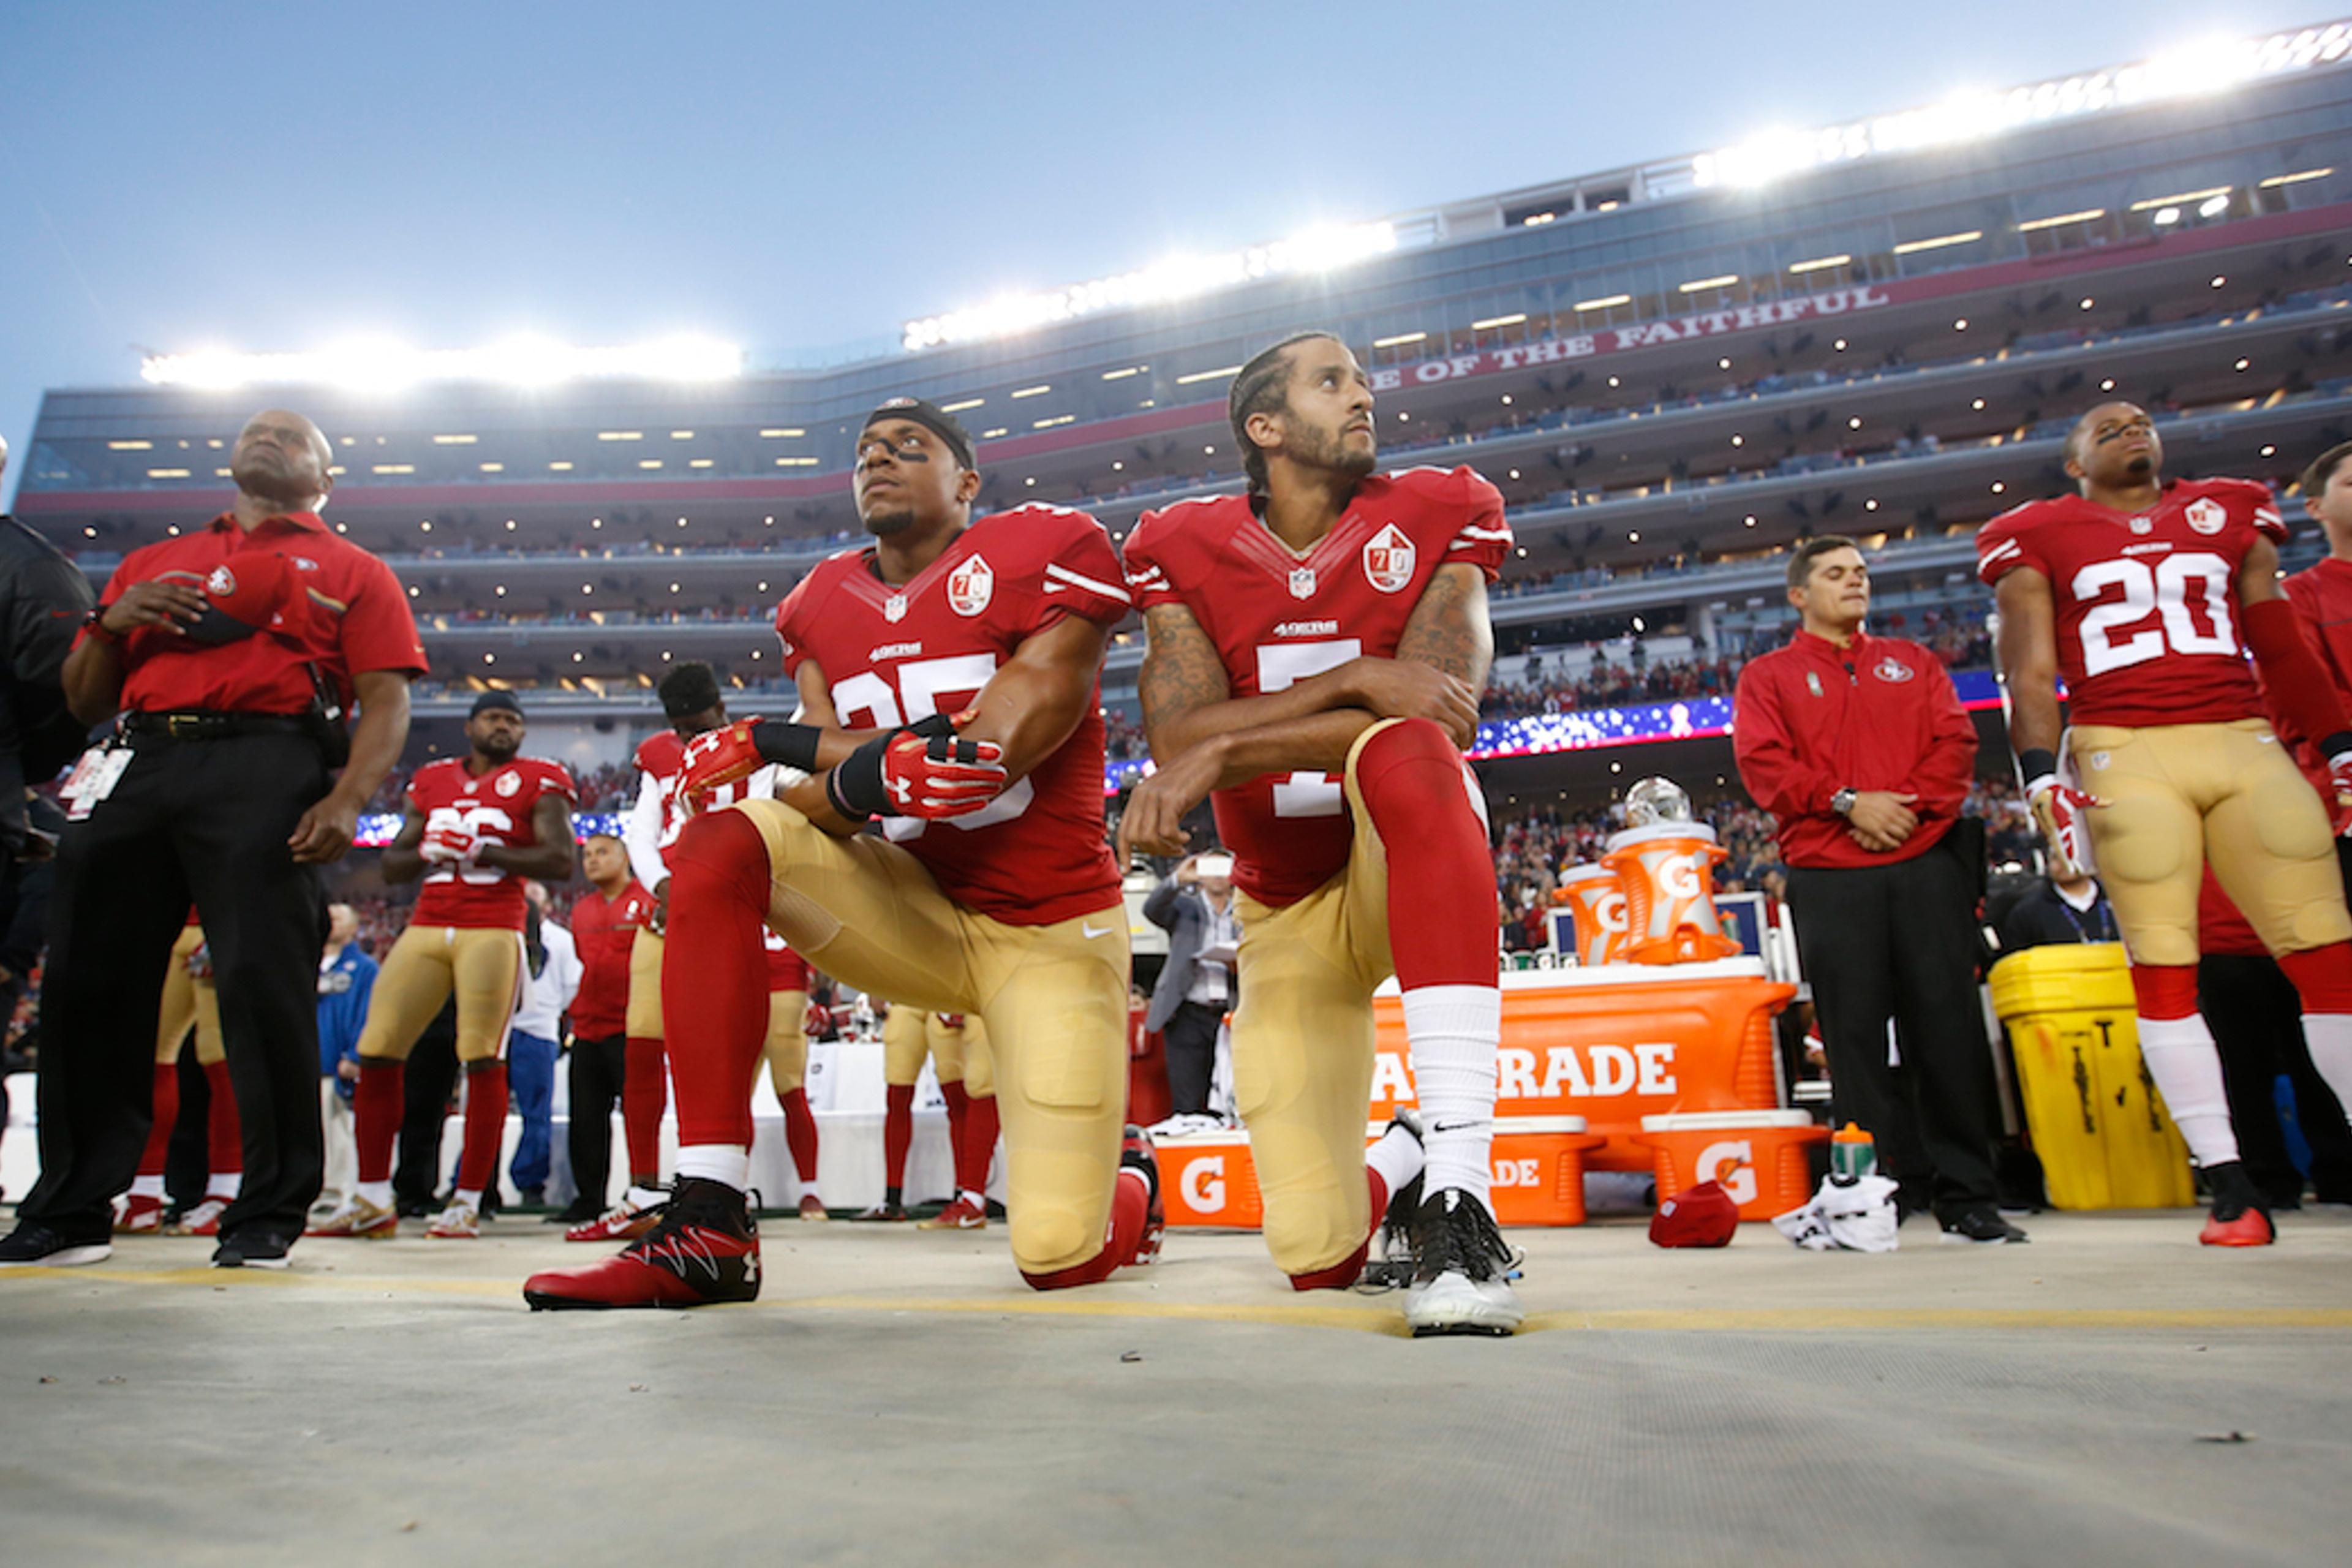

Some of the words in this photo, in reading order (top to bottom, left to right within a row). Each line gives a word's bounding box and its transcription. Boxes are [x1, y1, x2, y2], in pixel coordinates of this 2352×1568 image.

[1416, 355, 1480, 382] OF
[1491, 336, 1596, 369] THE
[1615, 287, 1888, 350] FAITHFUL
[2072, 552, 2238, 677] 20
[1256, 638, 1362, 816] 7
[1659, 854, 1700, 899] G
[1596, 892, 1629, 932] G
[1180, 1156, 1226, 1214] G
[1695, 1139, 1758, 1206] G
